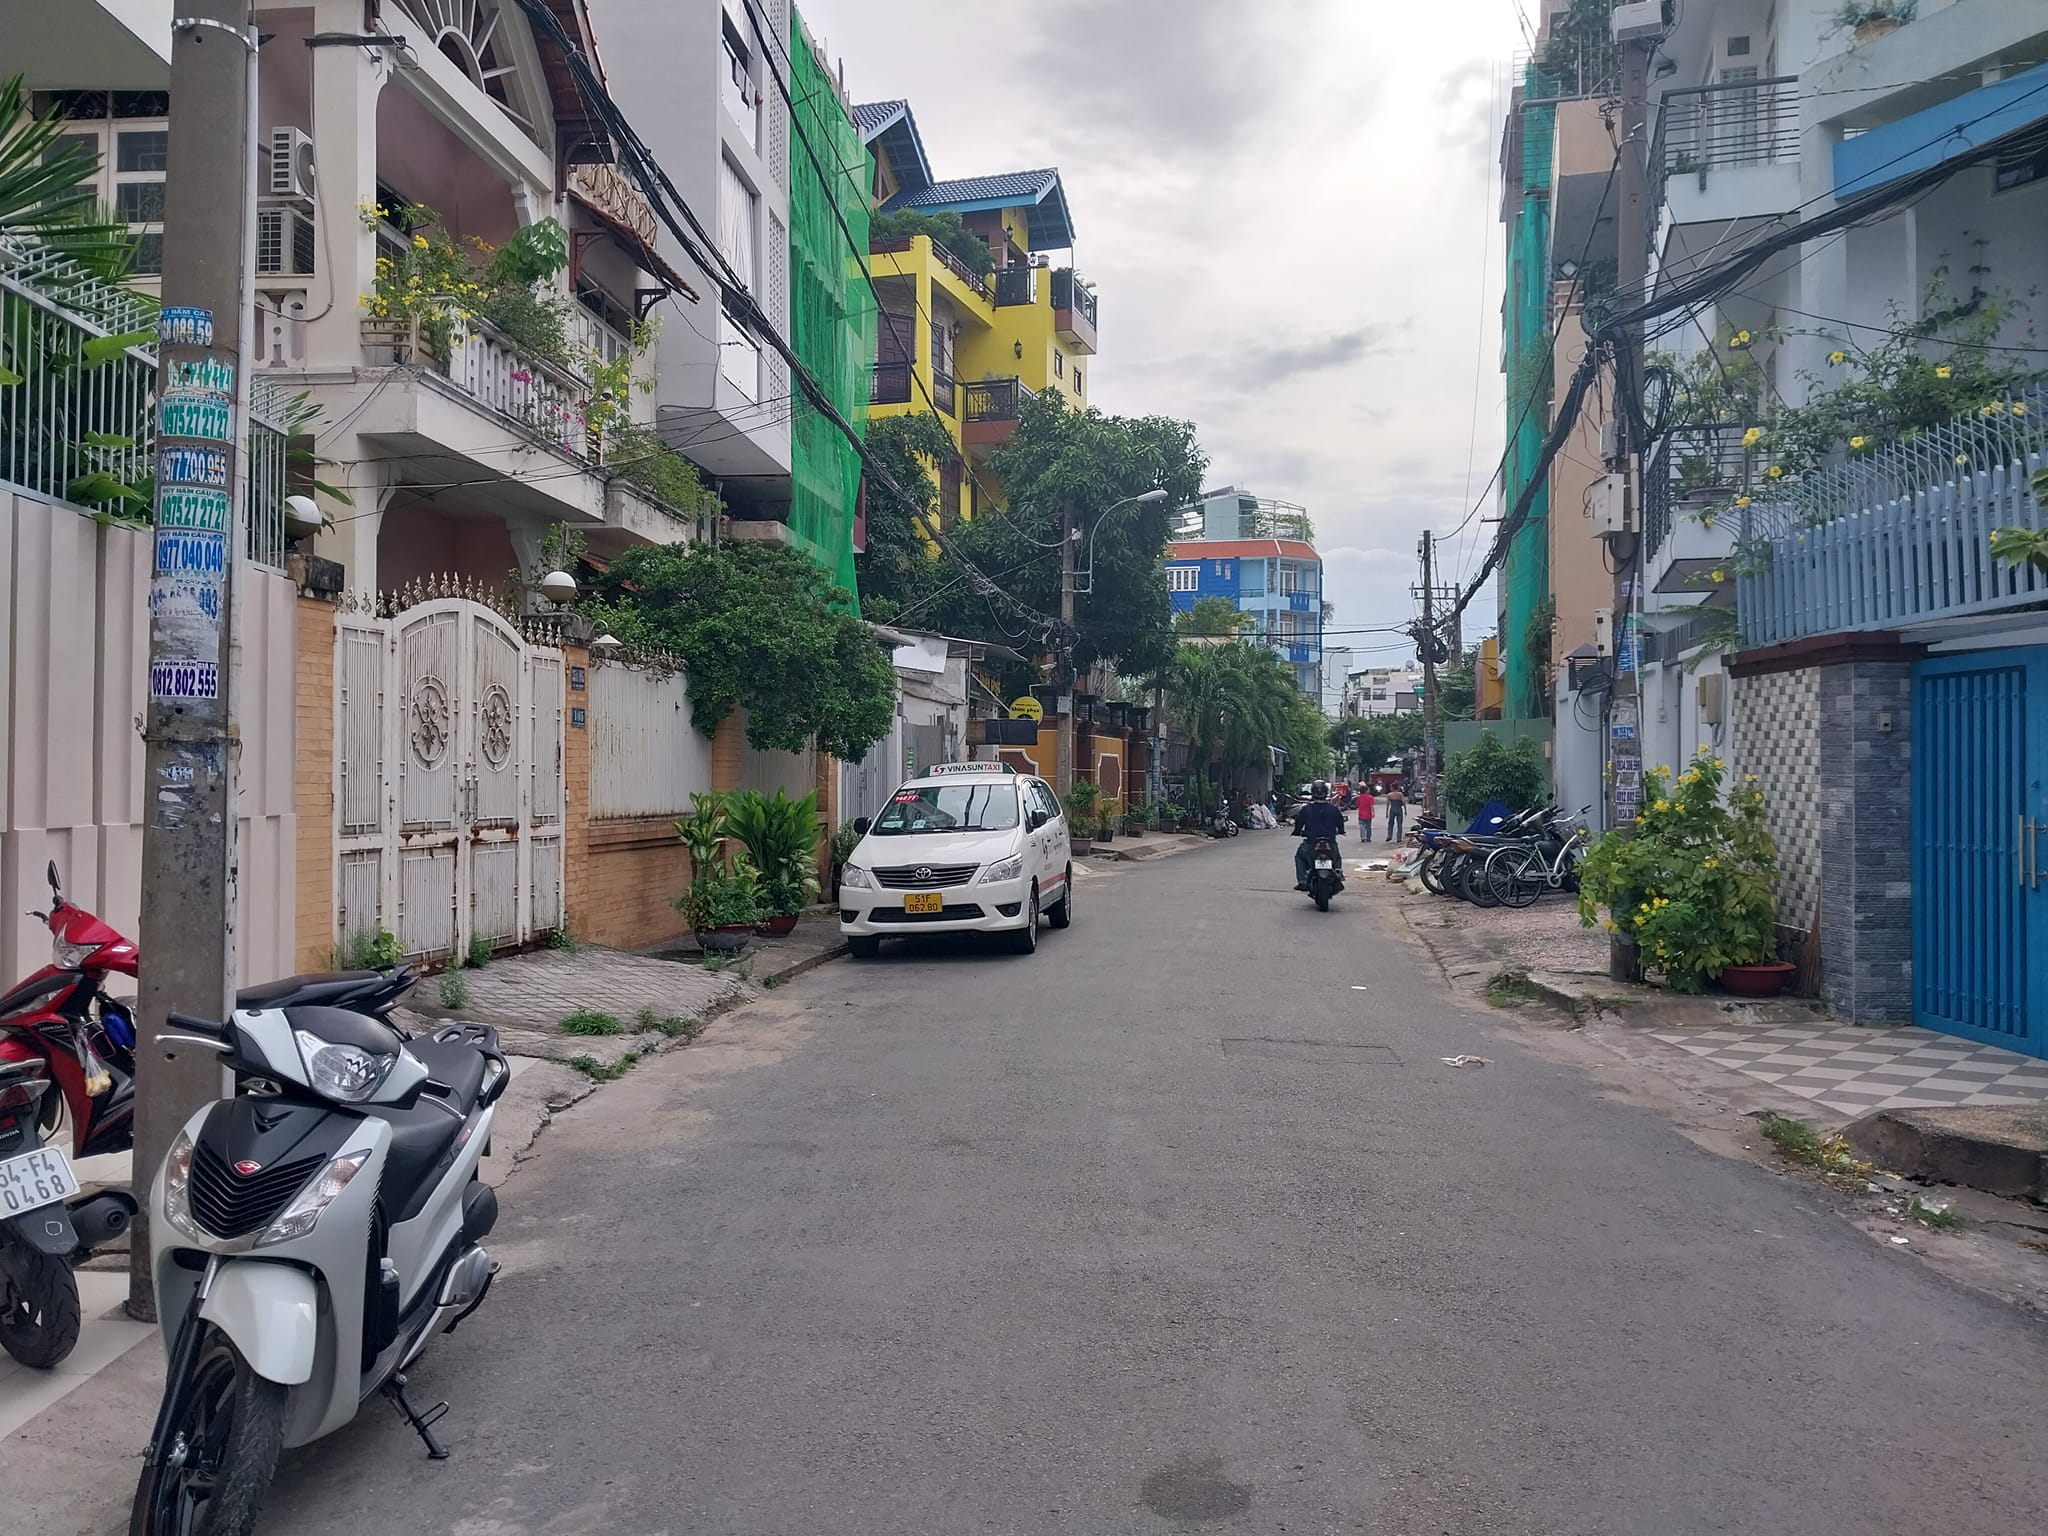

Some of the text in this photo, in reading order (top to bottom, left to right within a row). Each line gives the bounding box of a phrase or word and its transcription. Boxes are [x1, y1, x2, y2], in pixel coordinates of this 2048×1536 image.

[161, 495, 227, 531] 0975.27.27.27
[158, 539, 223, 573] 0977.040.040
[152, 668, 217, 698] 0812.802.555
[915, 894, 931, 903] 51F
[3, 1174, 66, 1210] 0468
